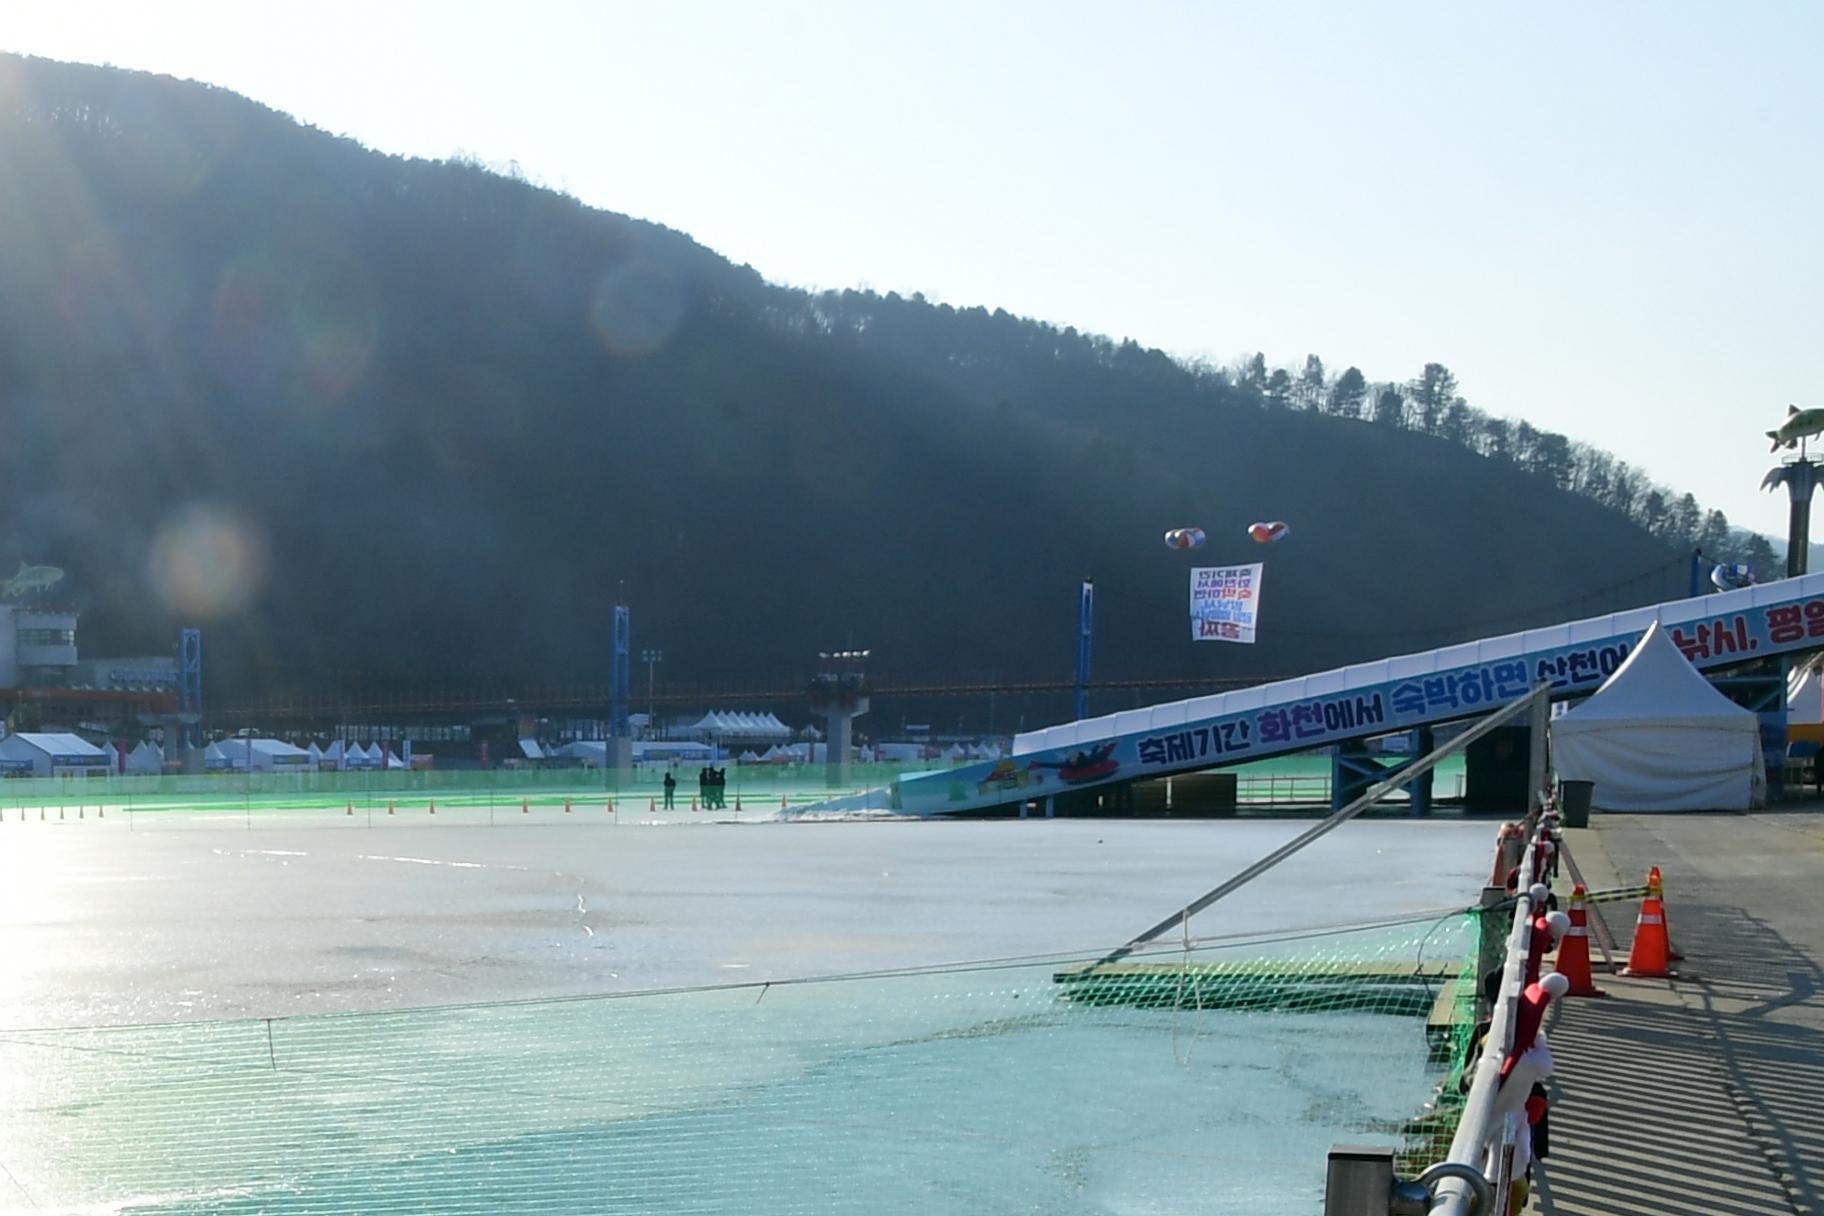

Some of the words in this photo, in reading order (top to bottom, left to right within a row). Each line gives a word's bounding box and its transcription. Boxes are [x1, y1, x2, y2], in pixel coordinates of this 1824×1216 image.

[1137, 719, 1250, 766] 축제기간
[1257, 693, 1384, 744] 화천에서
[1391, 660, 1530, 715] 숙박하면
